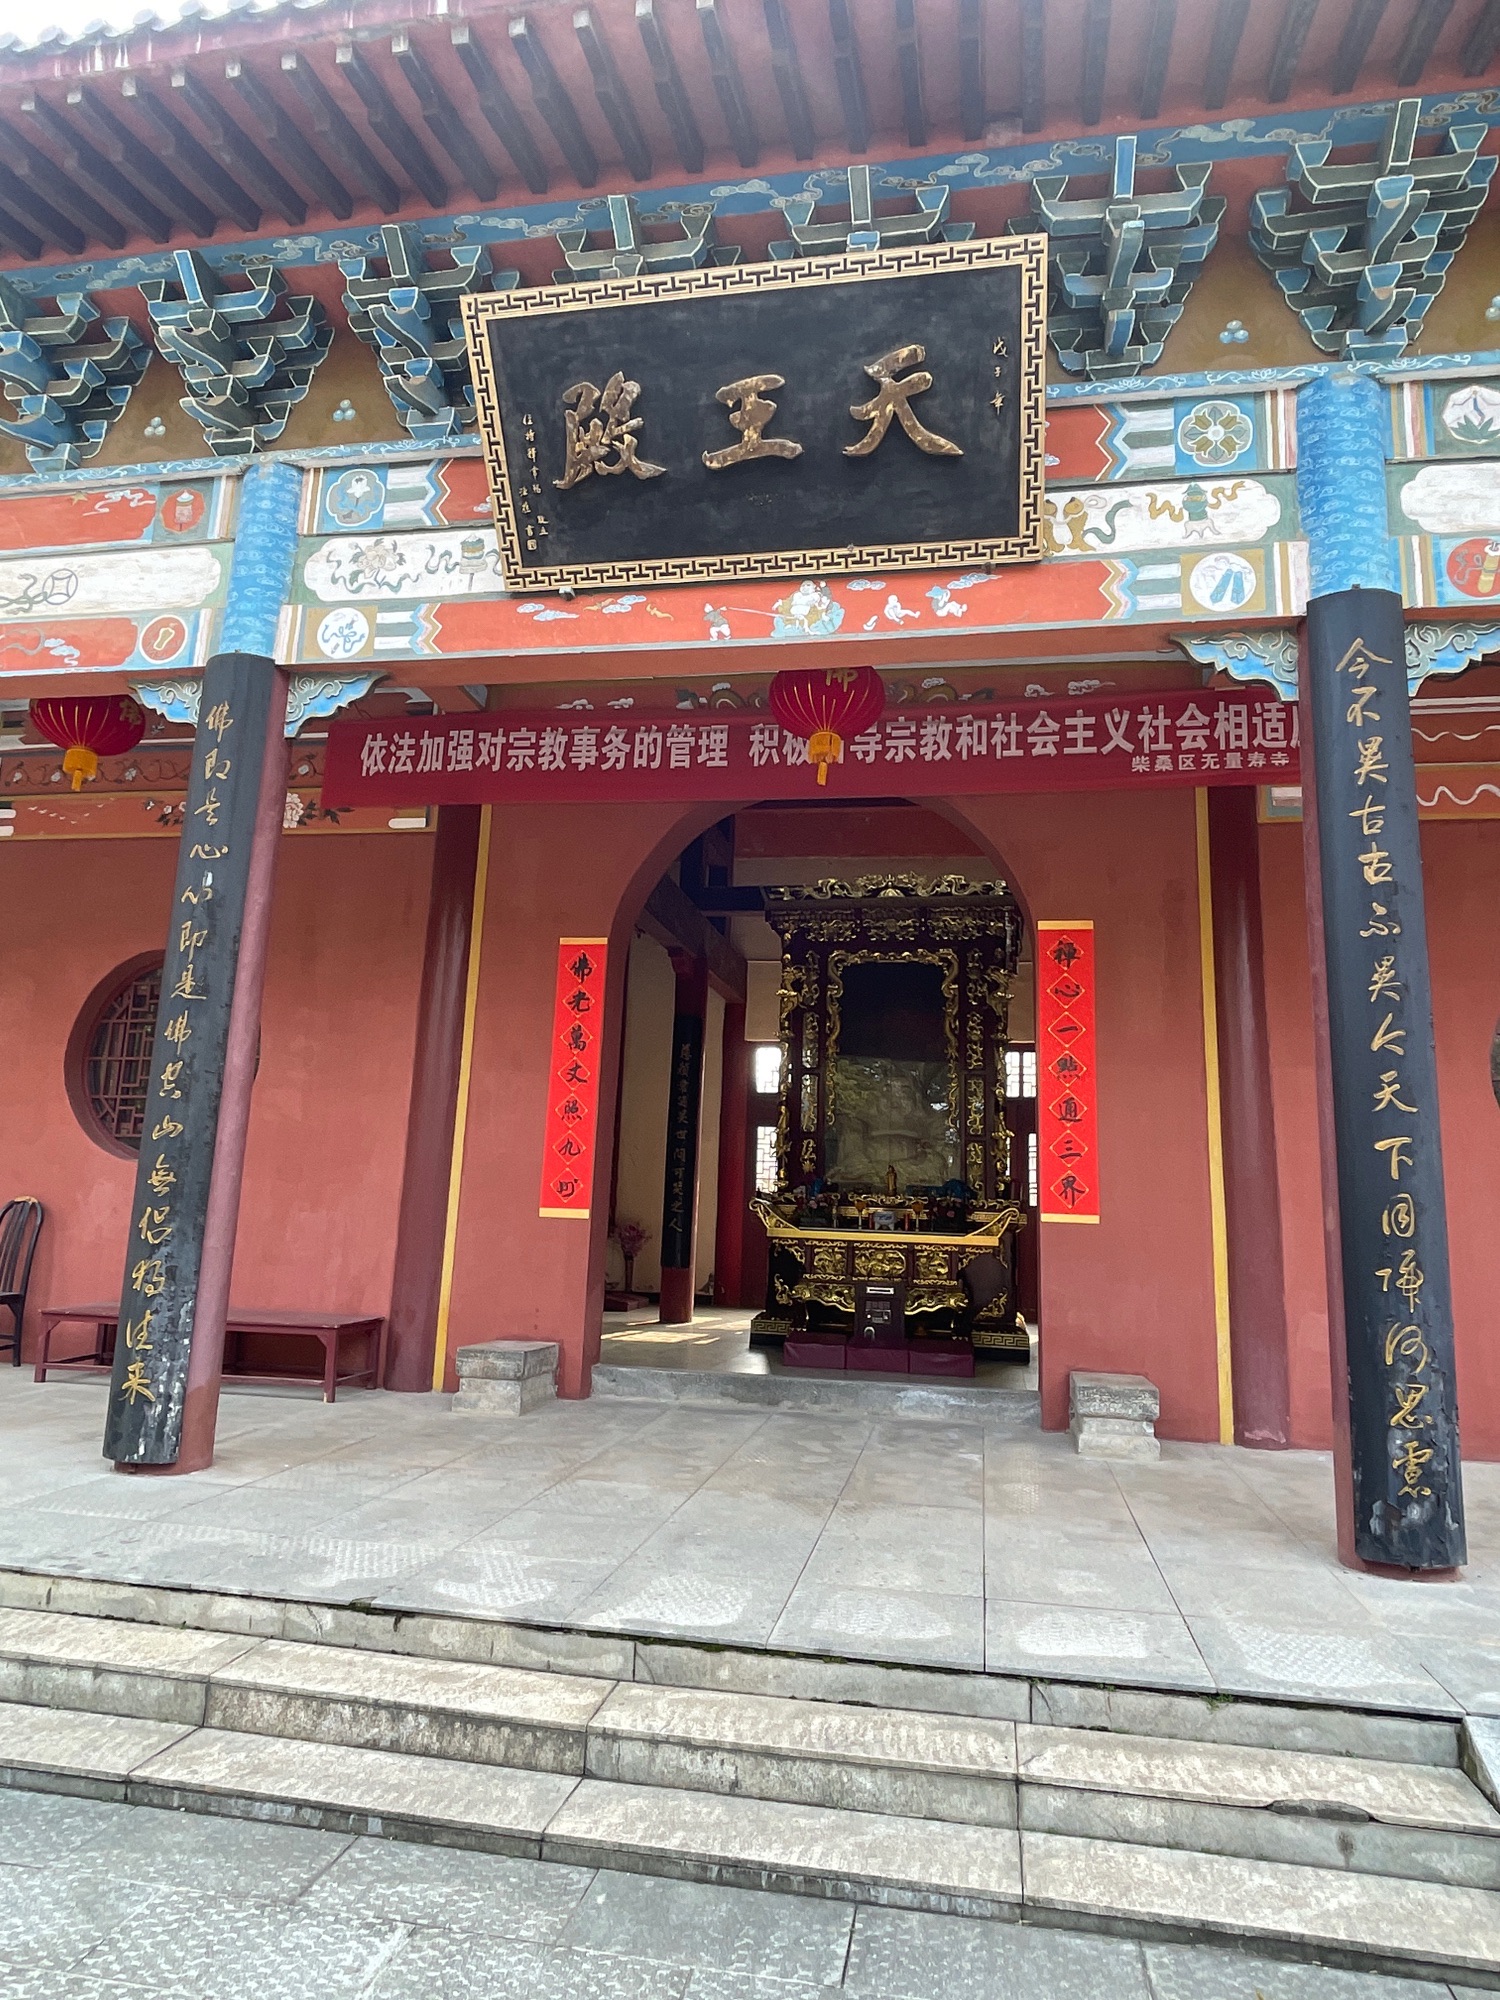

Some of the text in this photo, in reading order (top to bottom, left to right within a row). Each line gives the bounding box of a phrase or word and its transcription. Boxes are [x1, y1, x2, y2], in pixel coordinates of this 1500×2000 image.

[552, 344, 964, 490] 天王殿
[360, 701, 1300, 776] 依法加强对宗教事务的管理 积极导宗教和社会主义社会相适
[1131, 752, 1290, 773] 柴桑区无量寿寺
